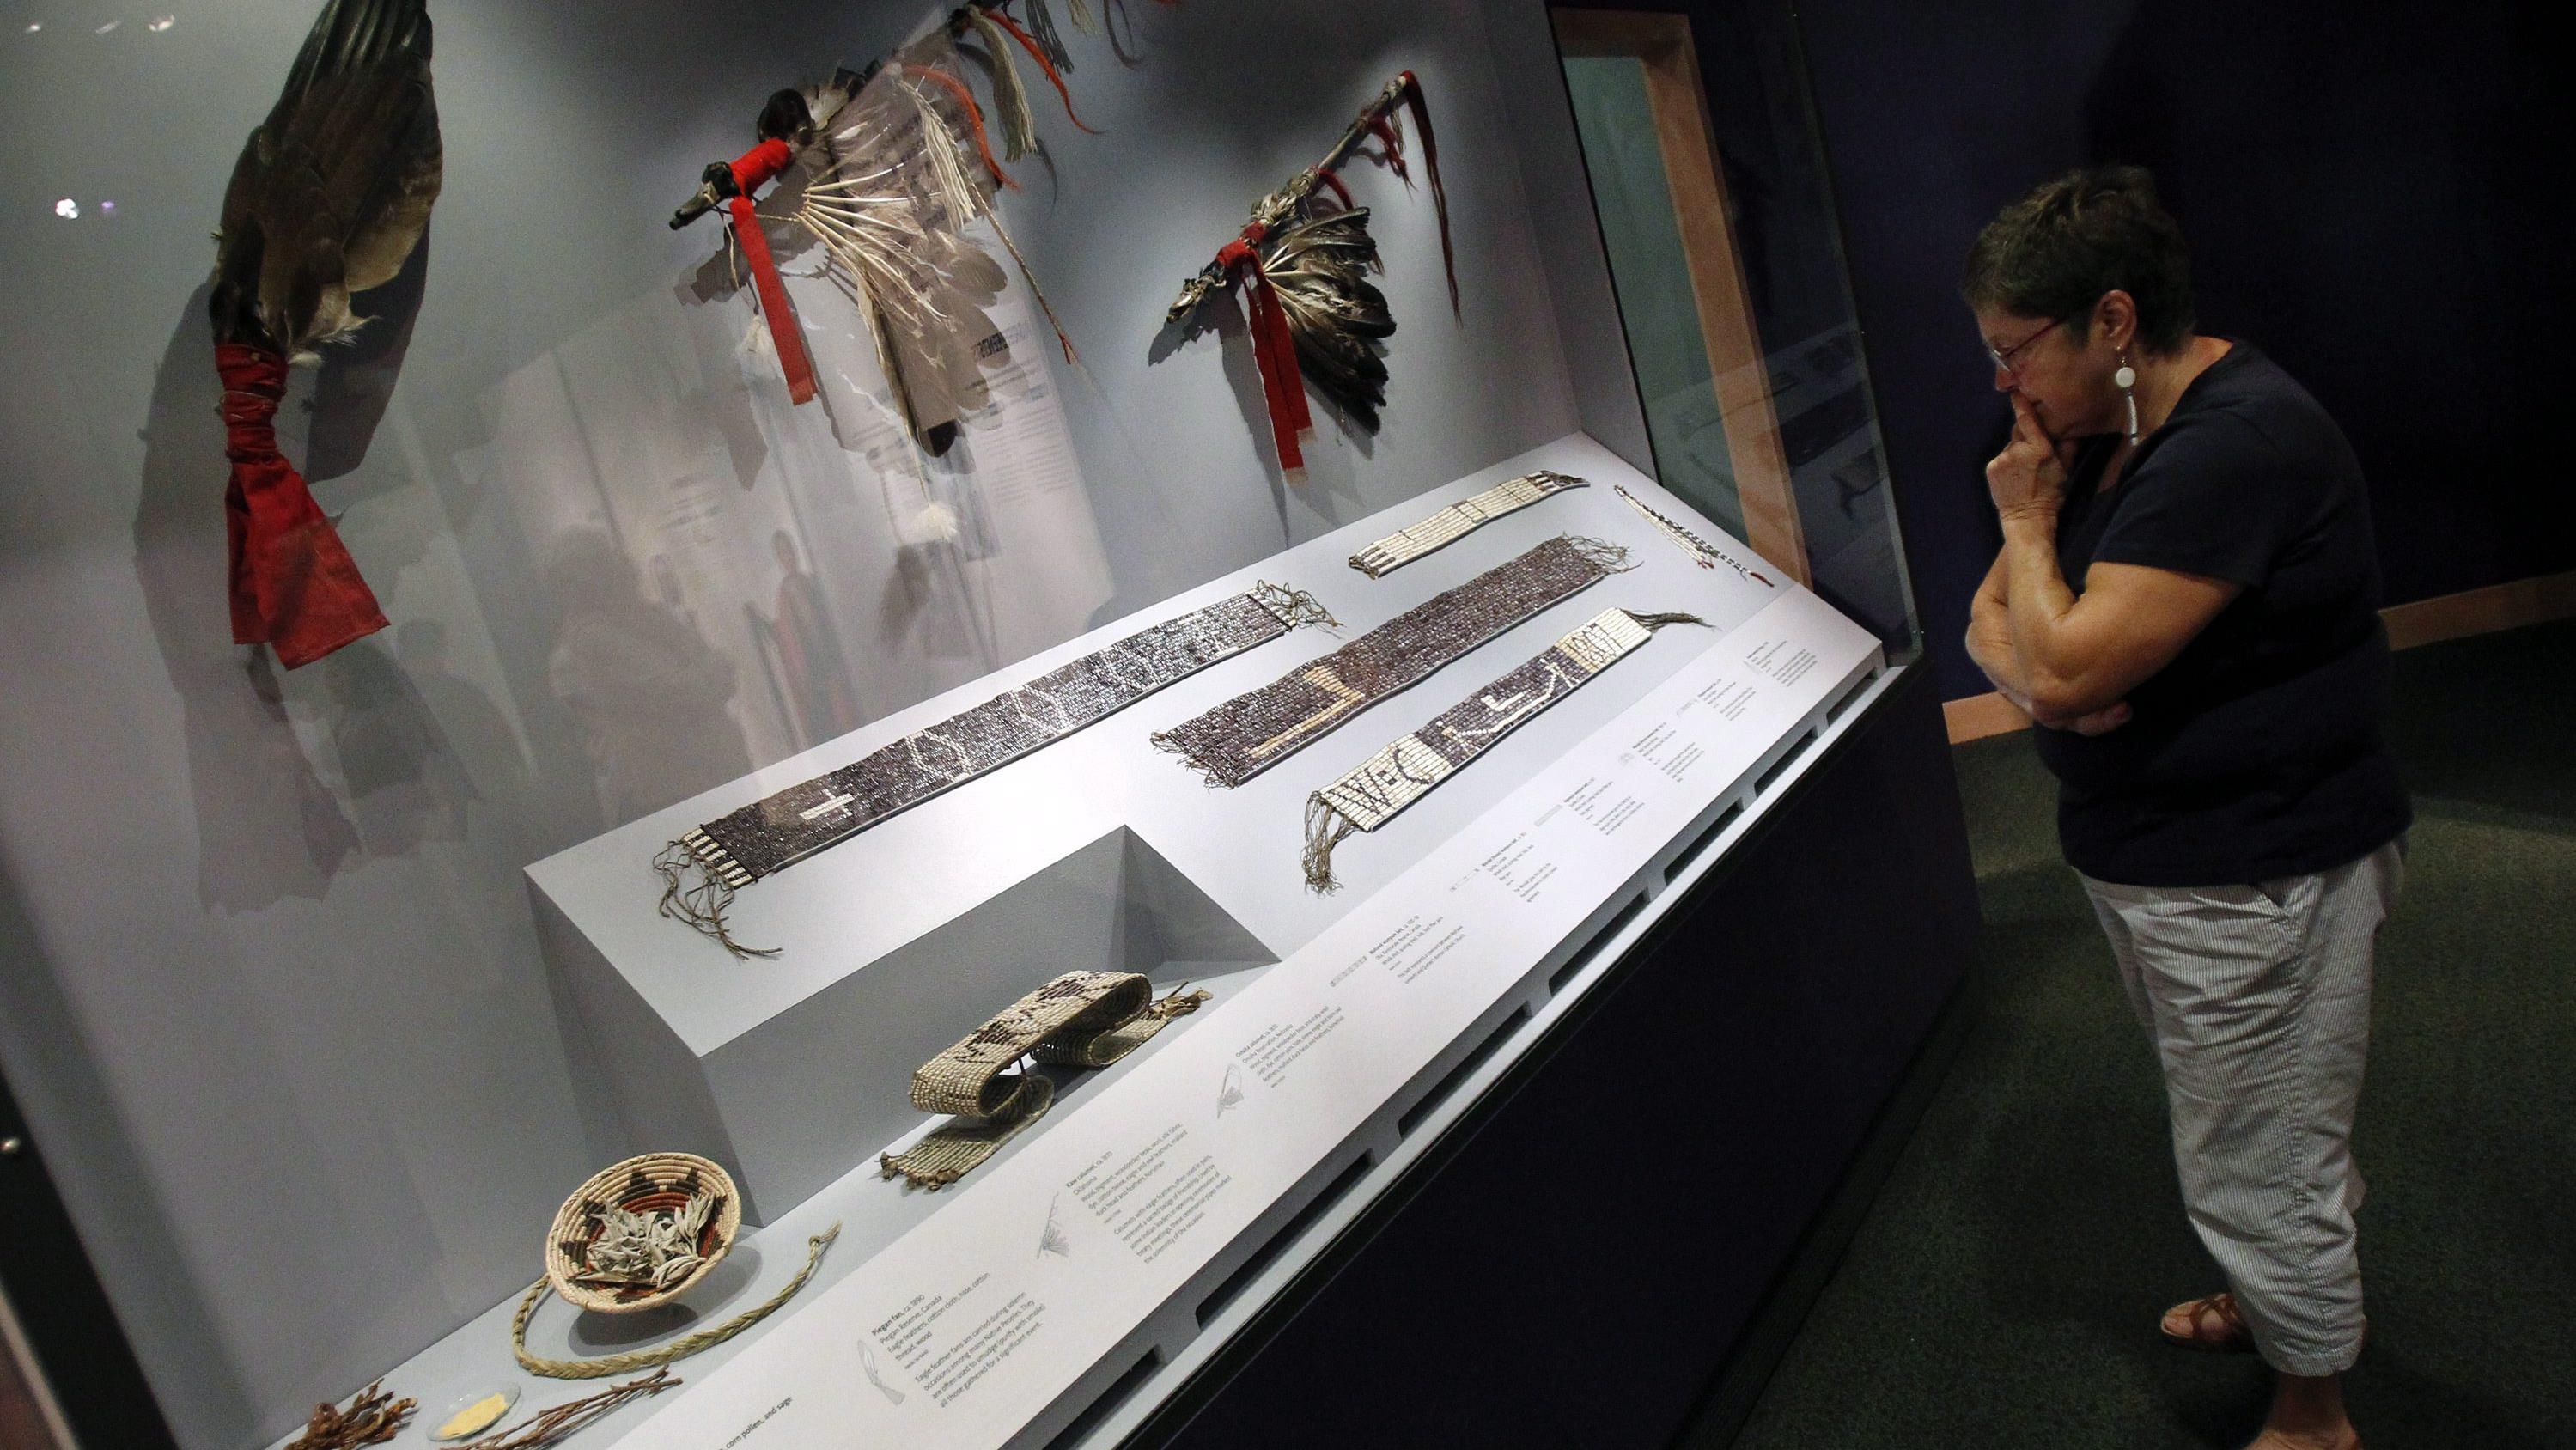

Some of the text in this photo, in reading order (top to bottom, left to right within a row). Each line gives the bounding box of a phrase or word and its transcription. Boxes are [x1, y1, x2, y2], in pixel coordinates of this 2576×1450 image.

[871, 1319, 893, 1337] Piegan
[891, 1311, 905, 1321] fan,
[910, 1294, 925, 1307] 1890
[879, 1295, 942, 1344] Piegan Reserve, Canada
[886, 1338, 904, 1353] Eagle
[927, 1307, 945, 1323] cotton
[971, 1272, 990, 1288] cotton
[914, 1368, 933, 1382] Eagle
[929, 1351, 951, 1370] feather
[950, 1342, 964, 1354] fans
[971, 1319, 991, 1337] carried
[1007, 1291, 1026, 1308] solemn
[915, 1330, 932, 1345] wood
[923, 1368, 951, 1391] occasions
[950, 1351, 971, 1370] among
[968, 1339, 985, 1354] many
[983, 1325, 1002, 1342] Native
[1020, 1299, 1035, 1311] They
[941, 1377, 958, 1392] often
[956, 1365, 971, 1379] used
[1014, 1319, 1027, 1331] with
[947, 1386, 965, 1401] those
[963, 1366, 988, 1390] gathered
[985, 1359, 996, 1369] for
[999, 1333, 1026, 1358] significant
[726, 1397, 792, 1448] corn pollen, and sage
